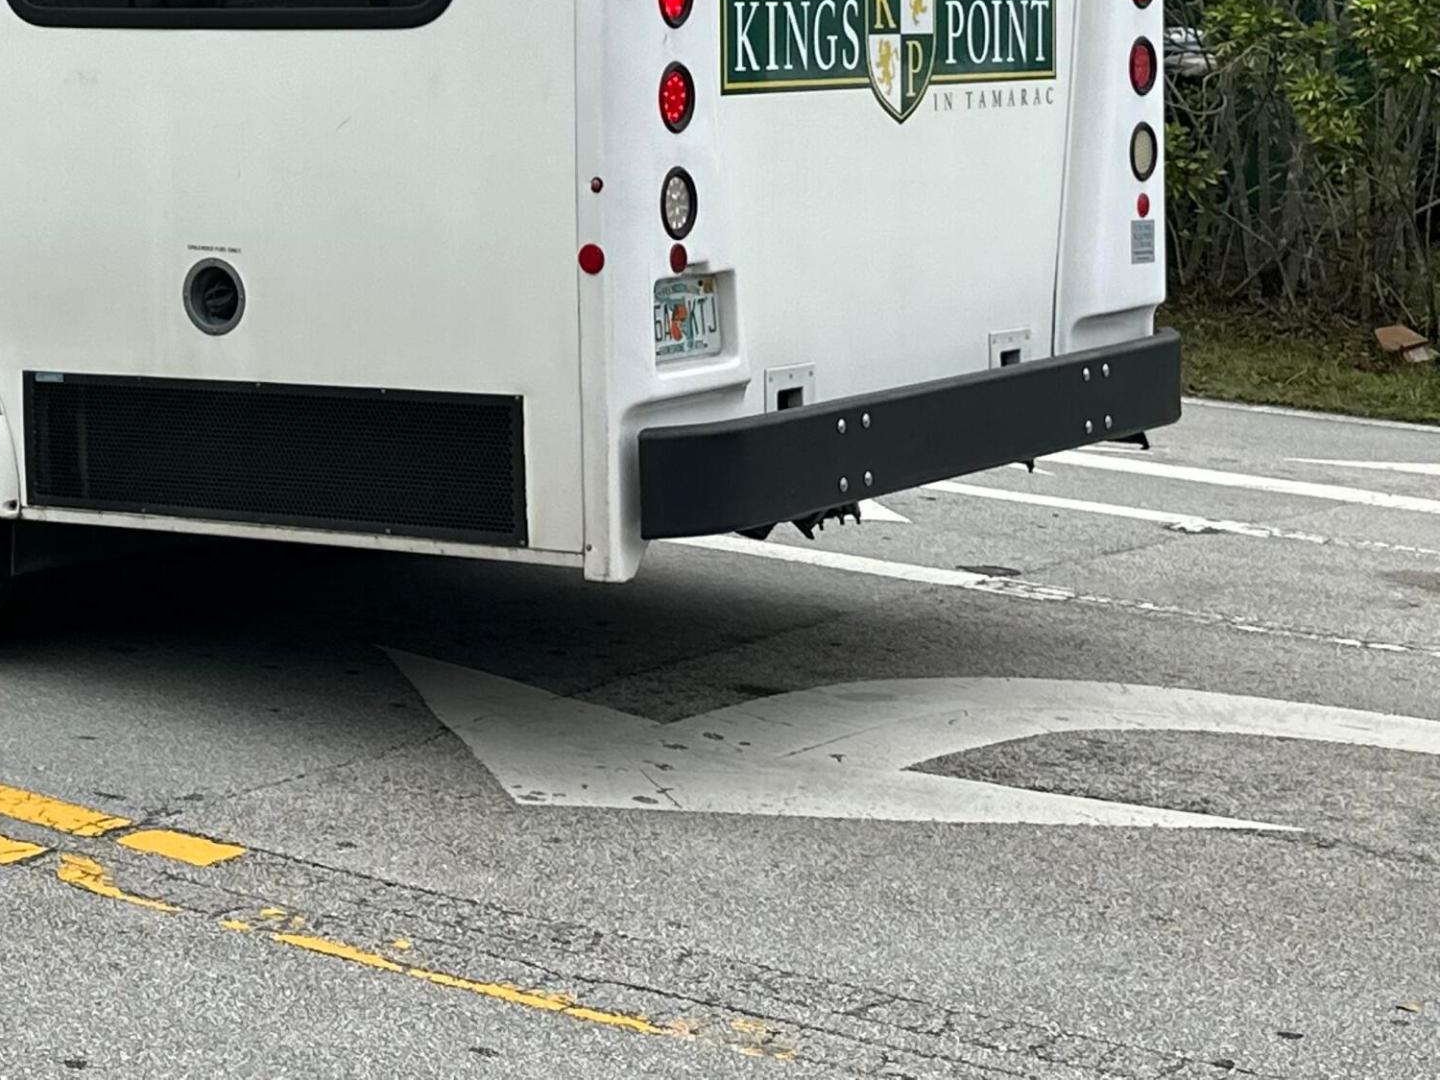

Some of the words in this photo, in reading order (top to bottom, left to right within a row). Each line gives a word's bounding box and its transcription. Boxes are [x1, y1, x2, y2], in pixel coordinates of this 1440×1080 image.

[734, 0, 860, 71] KINGS
[945, 0, 1049, 64] POINT
[906, 40, 923, 98] P
[933, 92, 953, 111] IN
[965, 86, 1055, 110] TAMARAC
